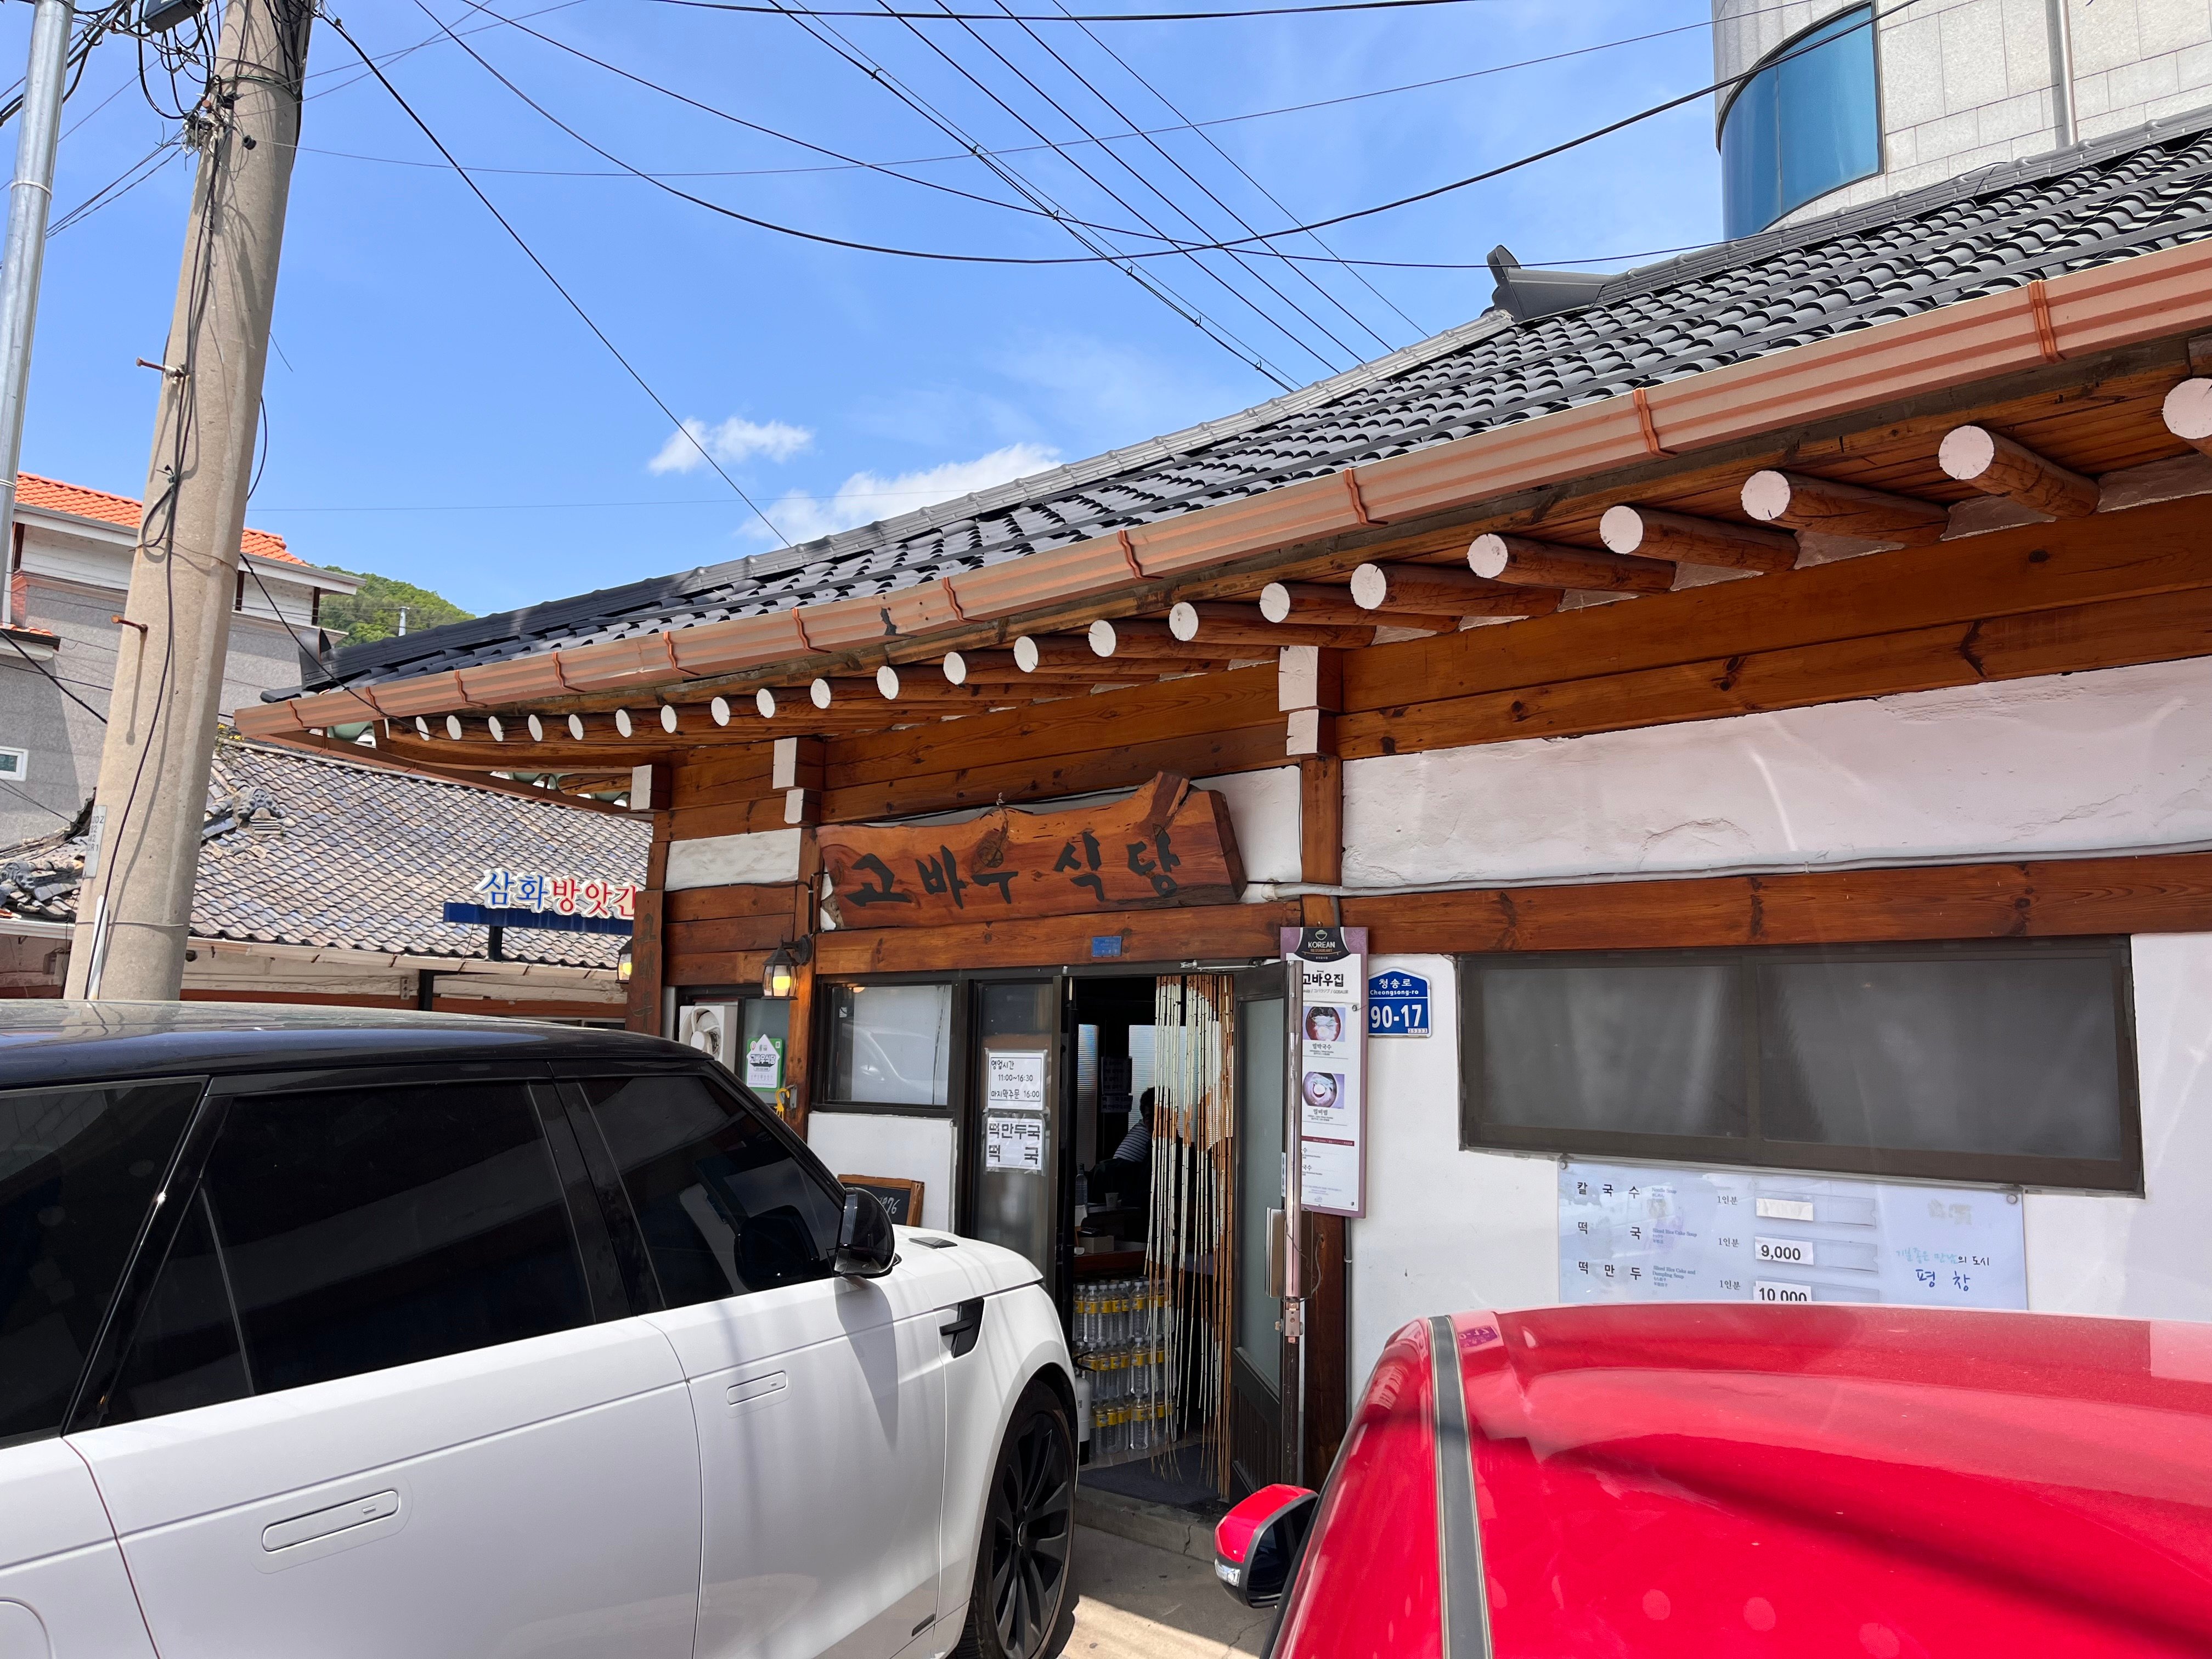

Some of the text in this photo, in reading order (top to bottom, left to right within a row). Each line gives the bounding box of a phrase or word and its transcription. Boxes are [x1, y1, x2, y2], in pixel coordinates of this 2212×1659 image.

[1303, 973, 1344, 987] 고바우집
[1379, 978, 1412, 989] 청송로
[1370, 1004, 1422, 1028] 90-17
[991, 1060, 1014, 1070] 영업시간
[991, 1089, 1020, 1099] 마지막주문
[989, 1122, 1041, 1141] 떡만두국
[1717, 1195, 1739, 1206] 1인분
[1718, 1238, 1740, 1248] 1인분
[1761, 1244, 1801, 1261] 9,000
[1972, 1256, 1989, 1266] 도시
[1719, 1280, 1741, 1290] 1인분
